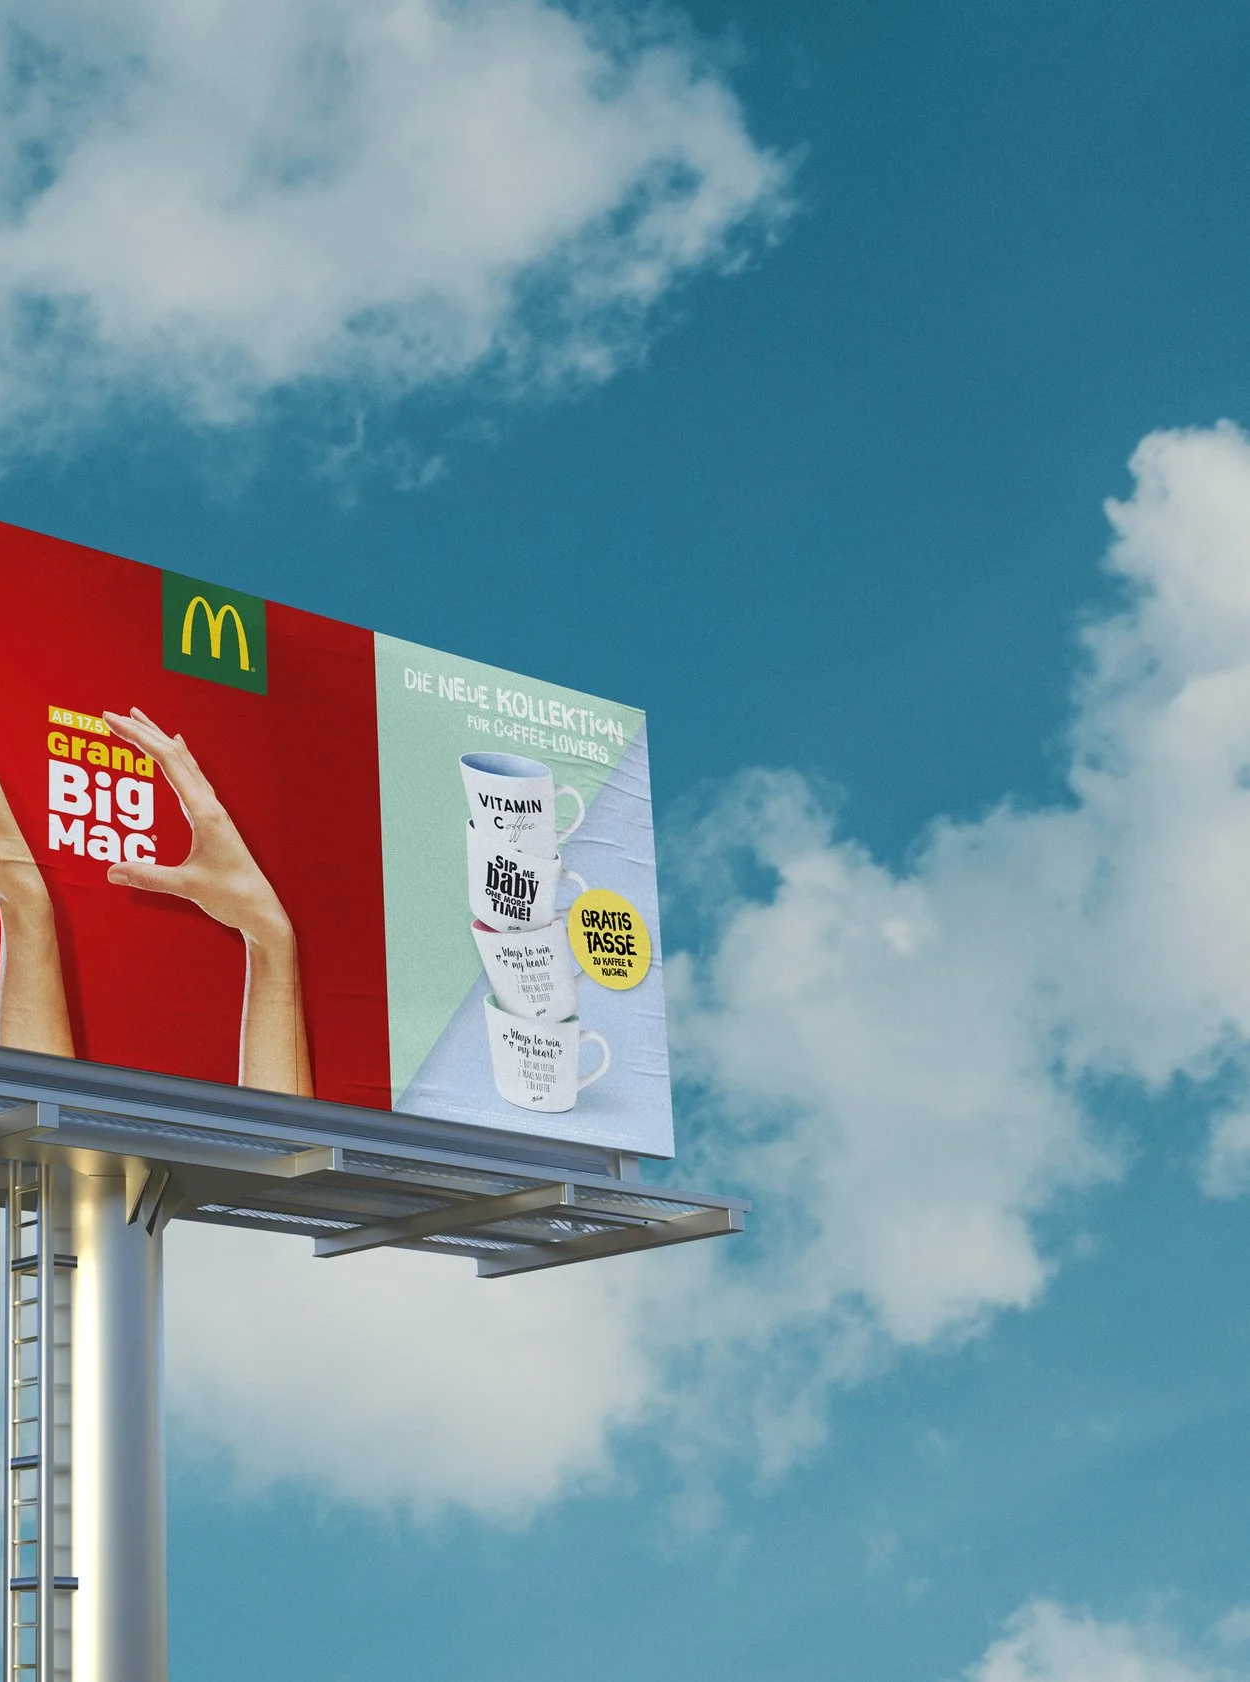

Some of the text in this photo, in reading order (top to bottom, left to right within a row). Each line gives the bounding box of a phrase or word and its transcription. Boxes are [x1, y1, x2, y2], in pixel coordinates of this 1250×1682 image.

[438, 675, 490, 710] NEUE
[51, 710, 108, 734] AB 17.5.
[47, 731, 154, 778] Grand
[49, 759, 154, 831] Big
[478, 792, 542, 813] VITAMIN
[495, 855, 535, 879] SIP ME
[486, 861, 539, 905] baby
[485, 888, 526, 907] ONE MORE
[491, 898, 531, 921] TIME!
[501, 945, 551, 961] Ways to win
[583, 931, 637, 956] TASSE
[512, 961, 524, 973] my
[593, 956, 633, 968] ZU KAFFEE &
[602, 967, 628, 978] KUCHEN
[511, 1028, 561, 1048] Ways to win
[517, 1045, 530, 1058] my
